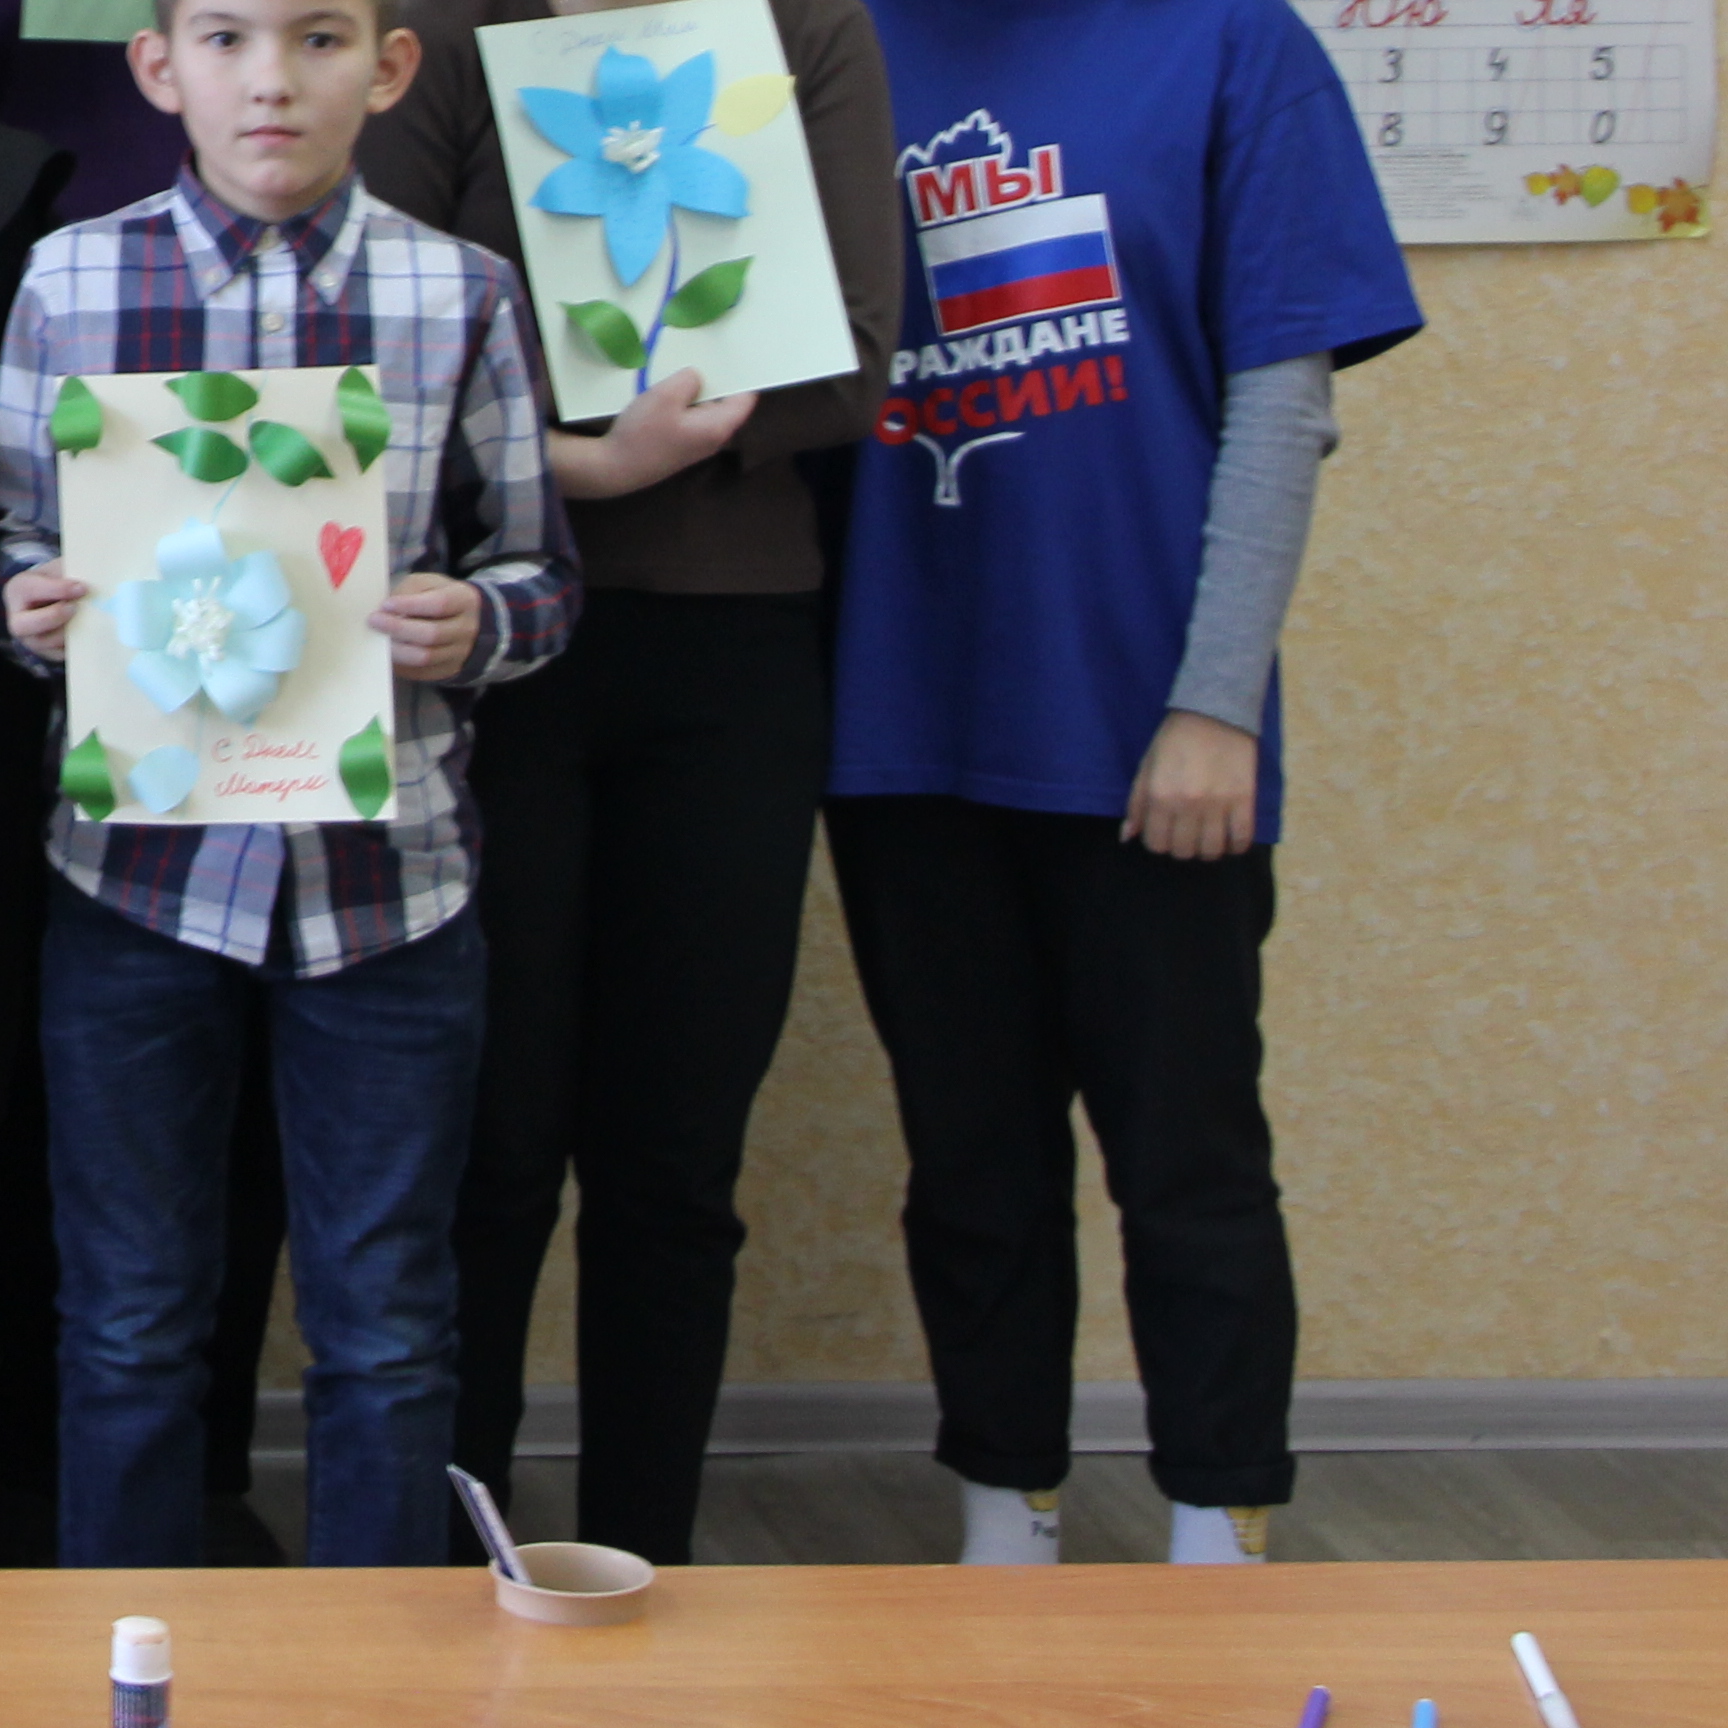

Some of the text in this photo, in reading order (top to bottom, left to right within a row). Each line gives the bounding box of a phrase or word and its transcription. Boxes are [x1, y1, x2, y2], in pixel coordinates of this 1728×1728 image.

[1590, 47, 1615, 80] 5
[906, 143, 1063, 228] МЫ
[888, 307, 1131, 385] РАЖДАНЕ
[873, 355, 1128, 446] ОССИИ!
